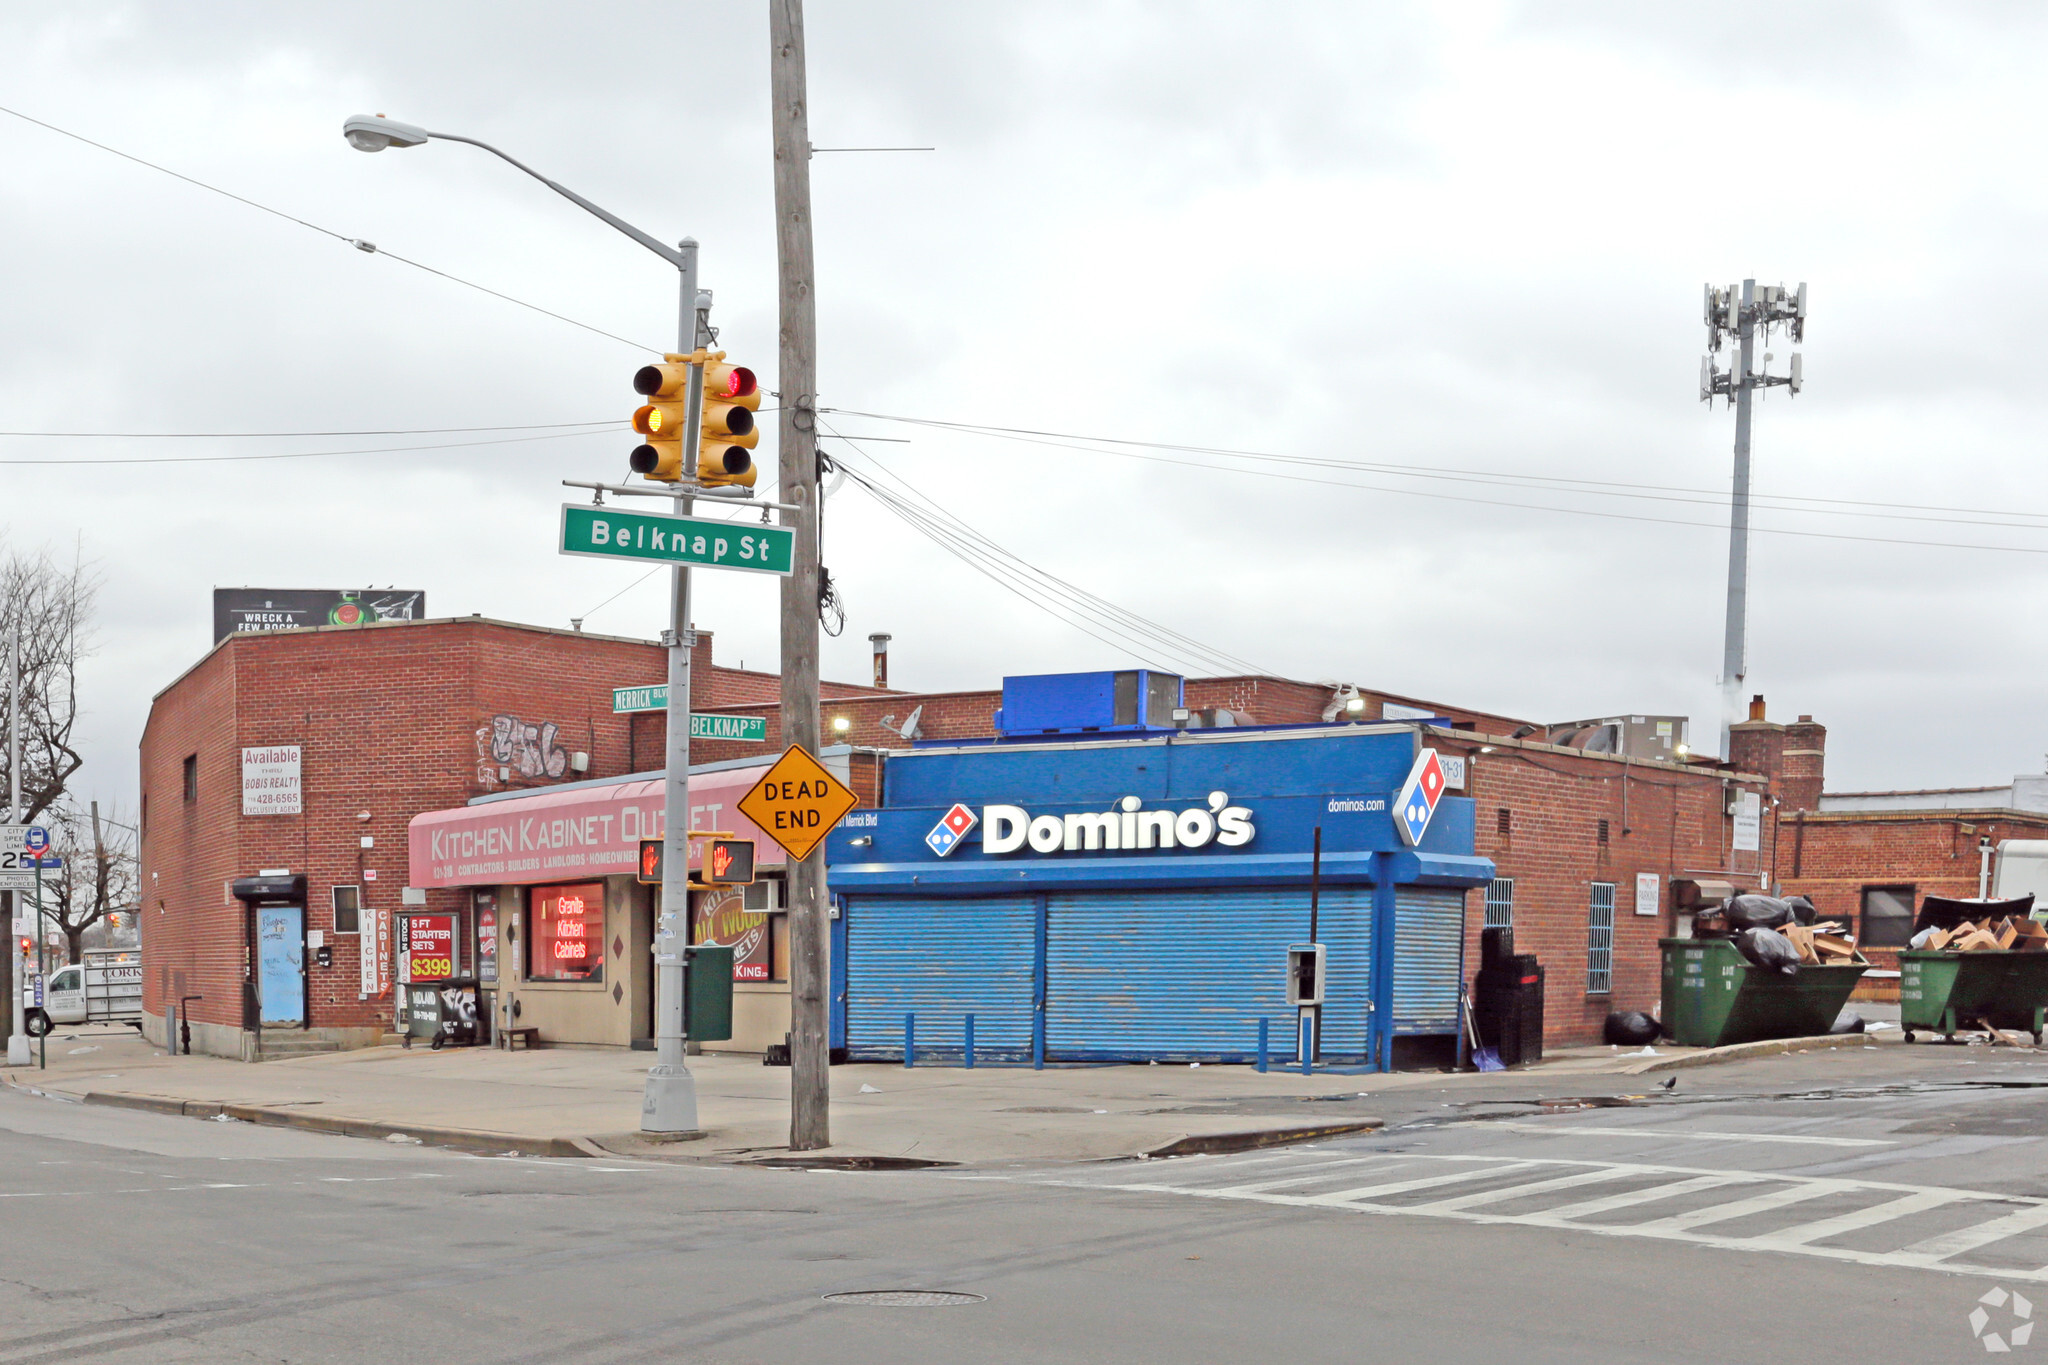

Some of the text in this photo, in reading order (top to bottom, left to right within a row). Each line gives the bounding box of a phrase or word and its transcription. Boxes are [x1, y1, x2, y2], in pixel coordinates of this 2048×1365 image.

[591, 520, 770, 563] Belknap St
[244, 613, 293, 623] WRECK A
[238, 623, 262, 632] FEW
[615, 688, 669, 710] MERRICK BLV
[691, 717, 762, 737] BELKNAP ST
[245, 748, 298, 765] Available
[245, 777, 299, 790] BOBIS REALTY
[765, 780, 829, 801] DEAD
[256, 793, 298, 804] 428-6565
[1328, 798, 1385, 812] dominos.com
[245, 806, 278, 814] EXCLUSIVE
[775, 809, 821, 829] END
[846, 815, 865, 827] Merrick
[865, 814, 878, 827] Blvd
[983, 791, 1255, 853] Domino's
[432, 826, 513, 861] KITCHEN
[520, 815, 614, 851] KABINET
[458, 861, 505, 876] CONTRACTORS
[508, 857, 540, 872] BUILDERS
[543, 853, 586, 869] LANDLORDS
[558, 896, 584, 914] Granite
[411, 919, 431, 929] 5 FT
[557, 919, 584, 937] Kitchen
[411, 930, 451, 940] STARTER
[364, 910, 374, 991] KITCHEN
[378, 911, 389, 992] CABINETS
[402, 942, 408, 951] IN
[411, 941, 435, 951] SETS
[554, 940, 586, 959] Cabinets
[411, 958, 451, 976] $399
[412, 991, 436, 1005] MIDLAND
